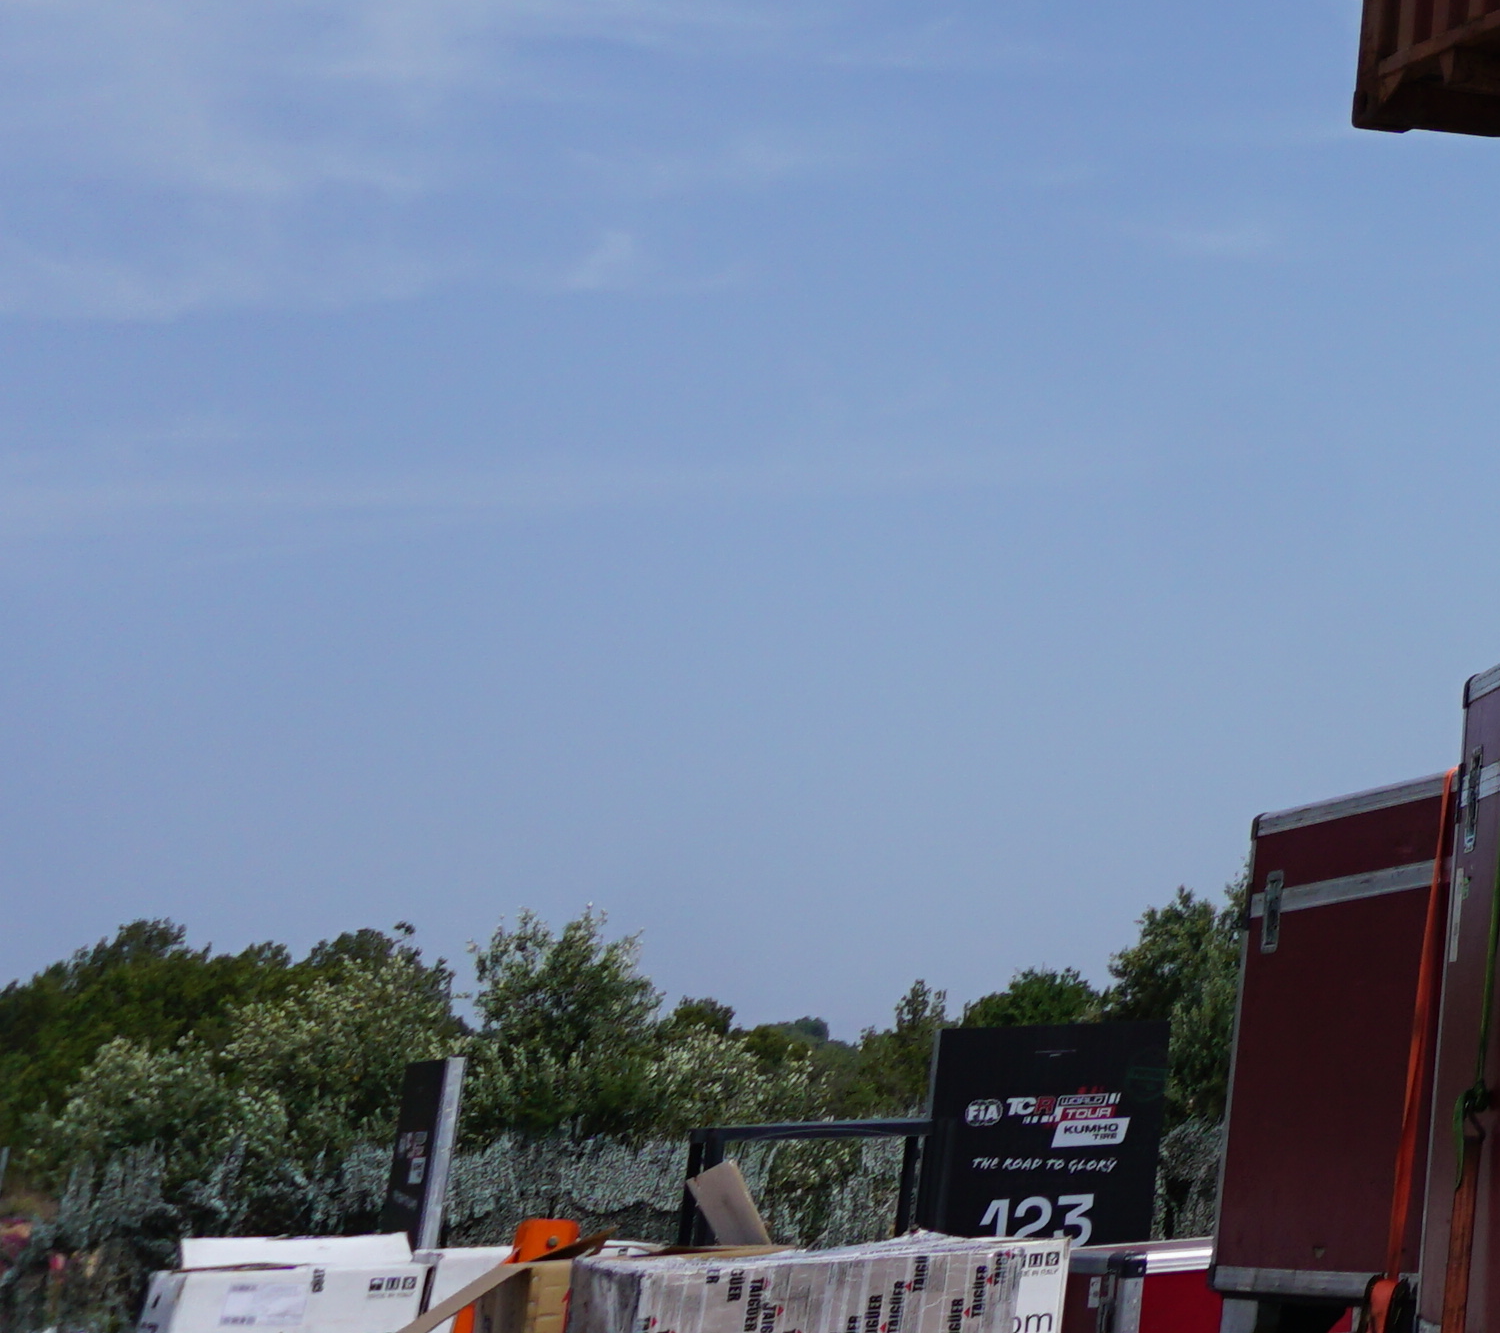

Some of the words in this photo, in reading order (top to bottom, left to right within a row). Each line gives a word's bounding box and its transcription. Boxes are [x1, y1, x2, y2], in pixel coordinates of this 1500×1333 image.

[1006, 1096, 1056, 1117] TCR
[1066, 1107, 1112, 1119] TOUR
[1064, 1122, 1119, 1134] KUMHO
[972, 1157, 999, 1170] THE
[1002, 1158, 1043, 1171] ROAD
[1046, 1158, 1064, 1170] TO
[1068, 1157, 1118, 1173] GLORY
[979, 1193, 1094, 1247] 123
